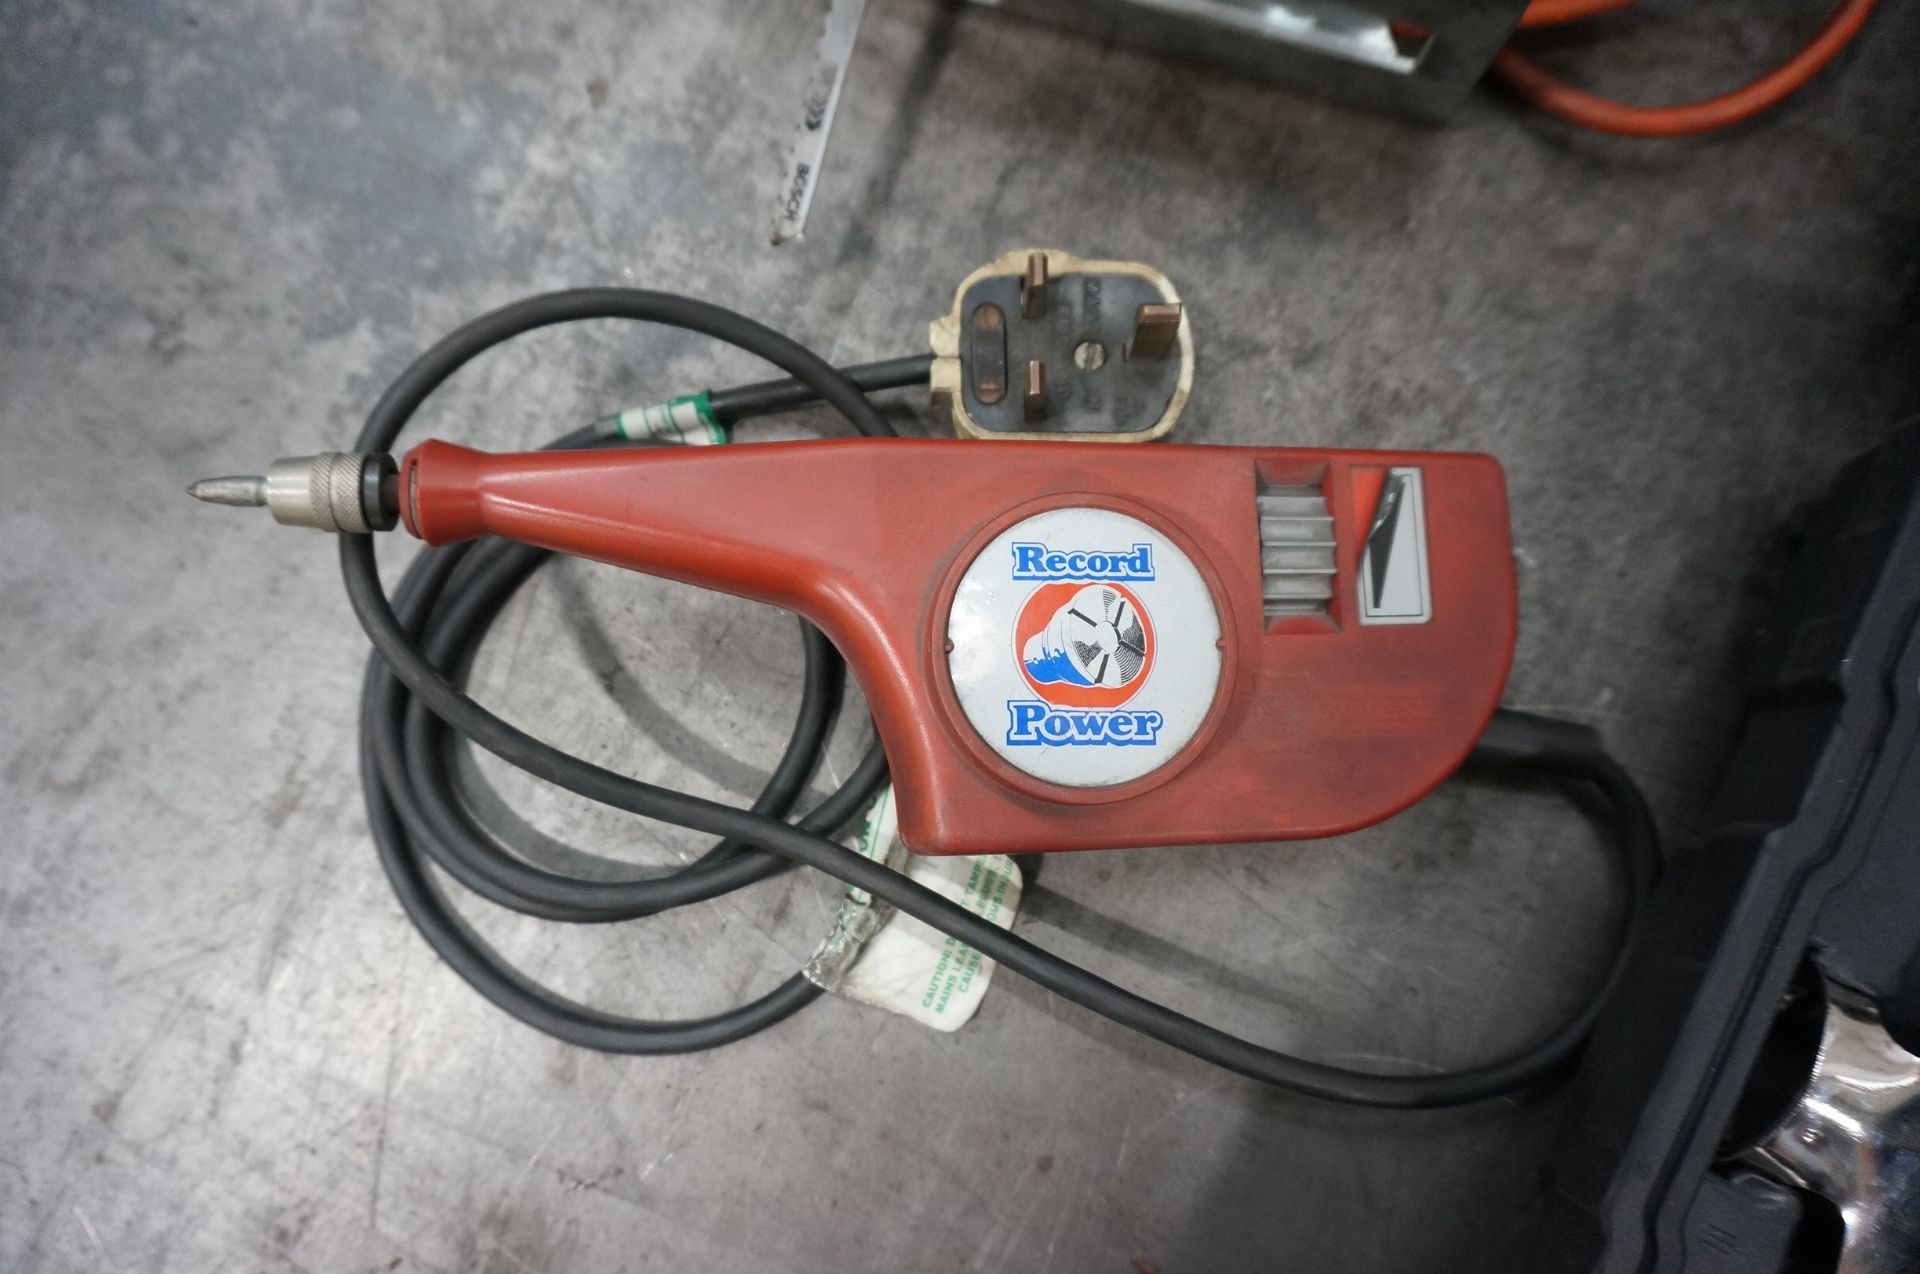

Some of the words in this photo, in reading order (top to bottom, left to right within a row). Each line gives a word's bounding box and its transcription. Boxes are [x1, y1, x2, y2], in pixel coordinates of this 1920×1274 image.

[784, 163, 810, 221] BOSCH
[1014, 544, 1152, 576] Record
[1010, 702, 1161, 740] Power
[964, 855, 987, 895] TAMPE
[935, 975, 957, 1014] MAINS
[955, 943, 969, 972] LEA
[959, 951, 982, 993] CAUSE
